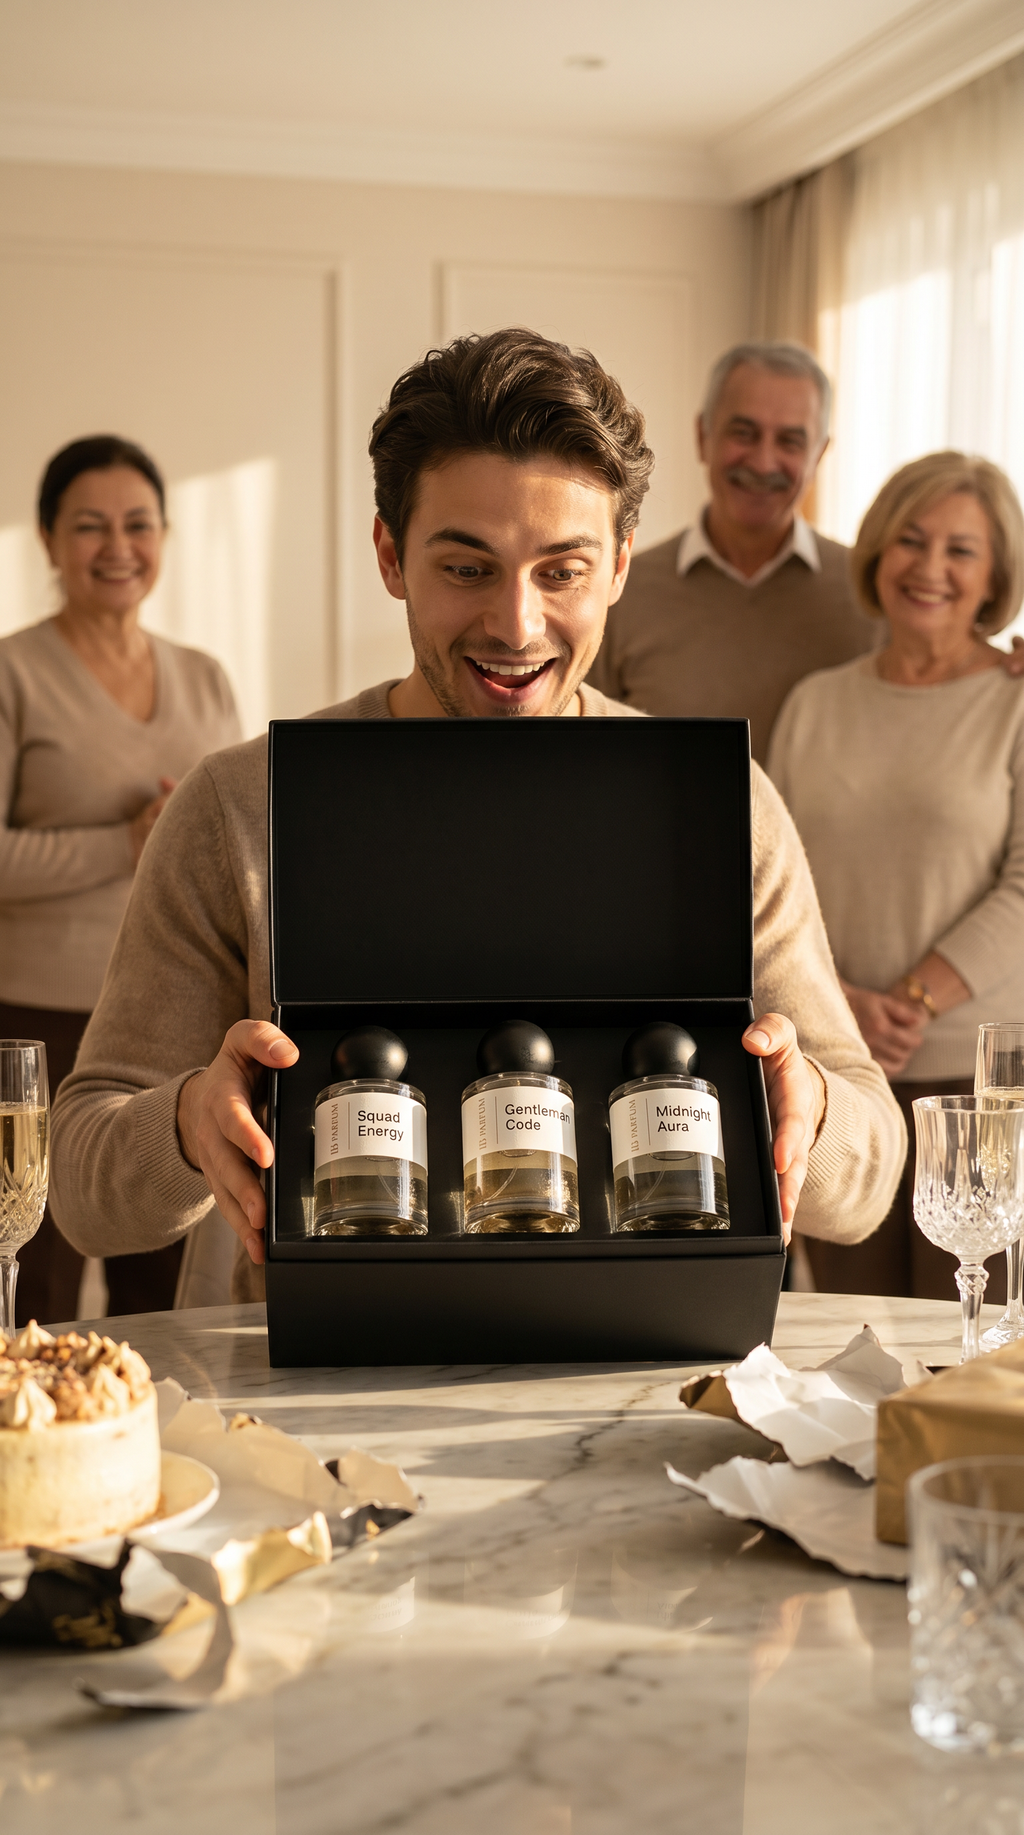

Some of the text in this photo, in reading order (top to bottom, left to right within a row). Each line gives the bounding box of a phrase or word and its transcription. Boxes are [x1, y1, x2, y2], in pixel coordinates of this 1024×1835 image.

[357, 1110, 400, 1124] Squad
[504, 1103, 571, 1124] Gentleman
[656, 1105, 711, 1122] Midnight
[505, 1118, 541, 1131] Code
[657, 1120, 689, 1132] Aura
[358, 1125, 404, 1141] Energy
